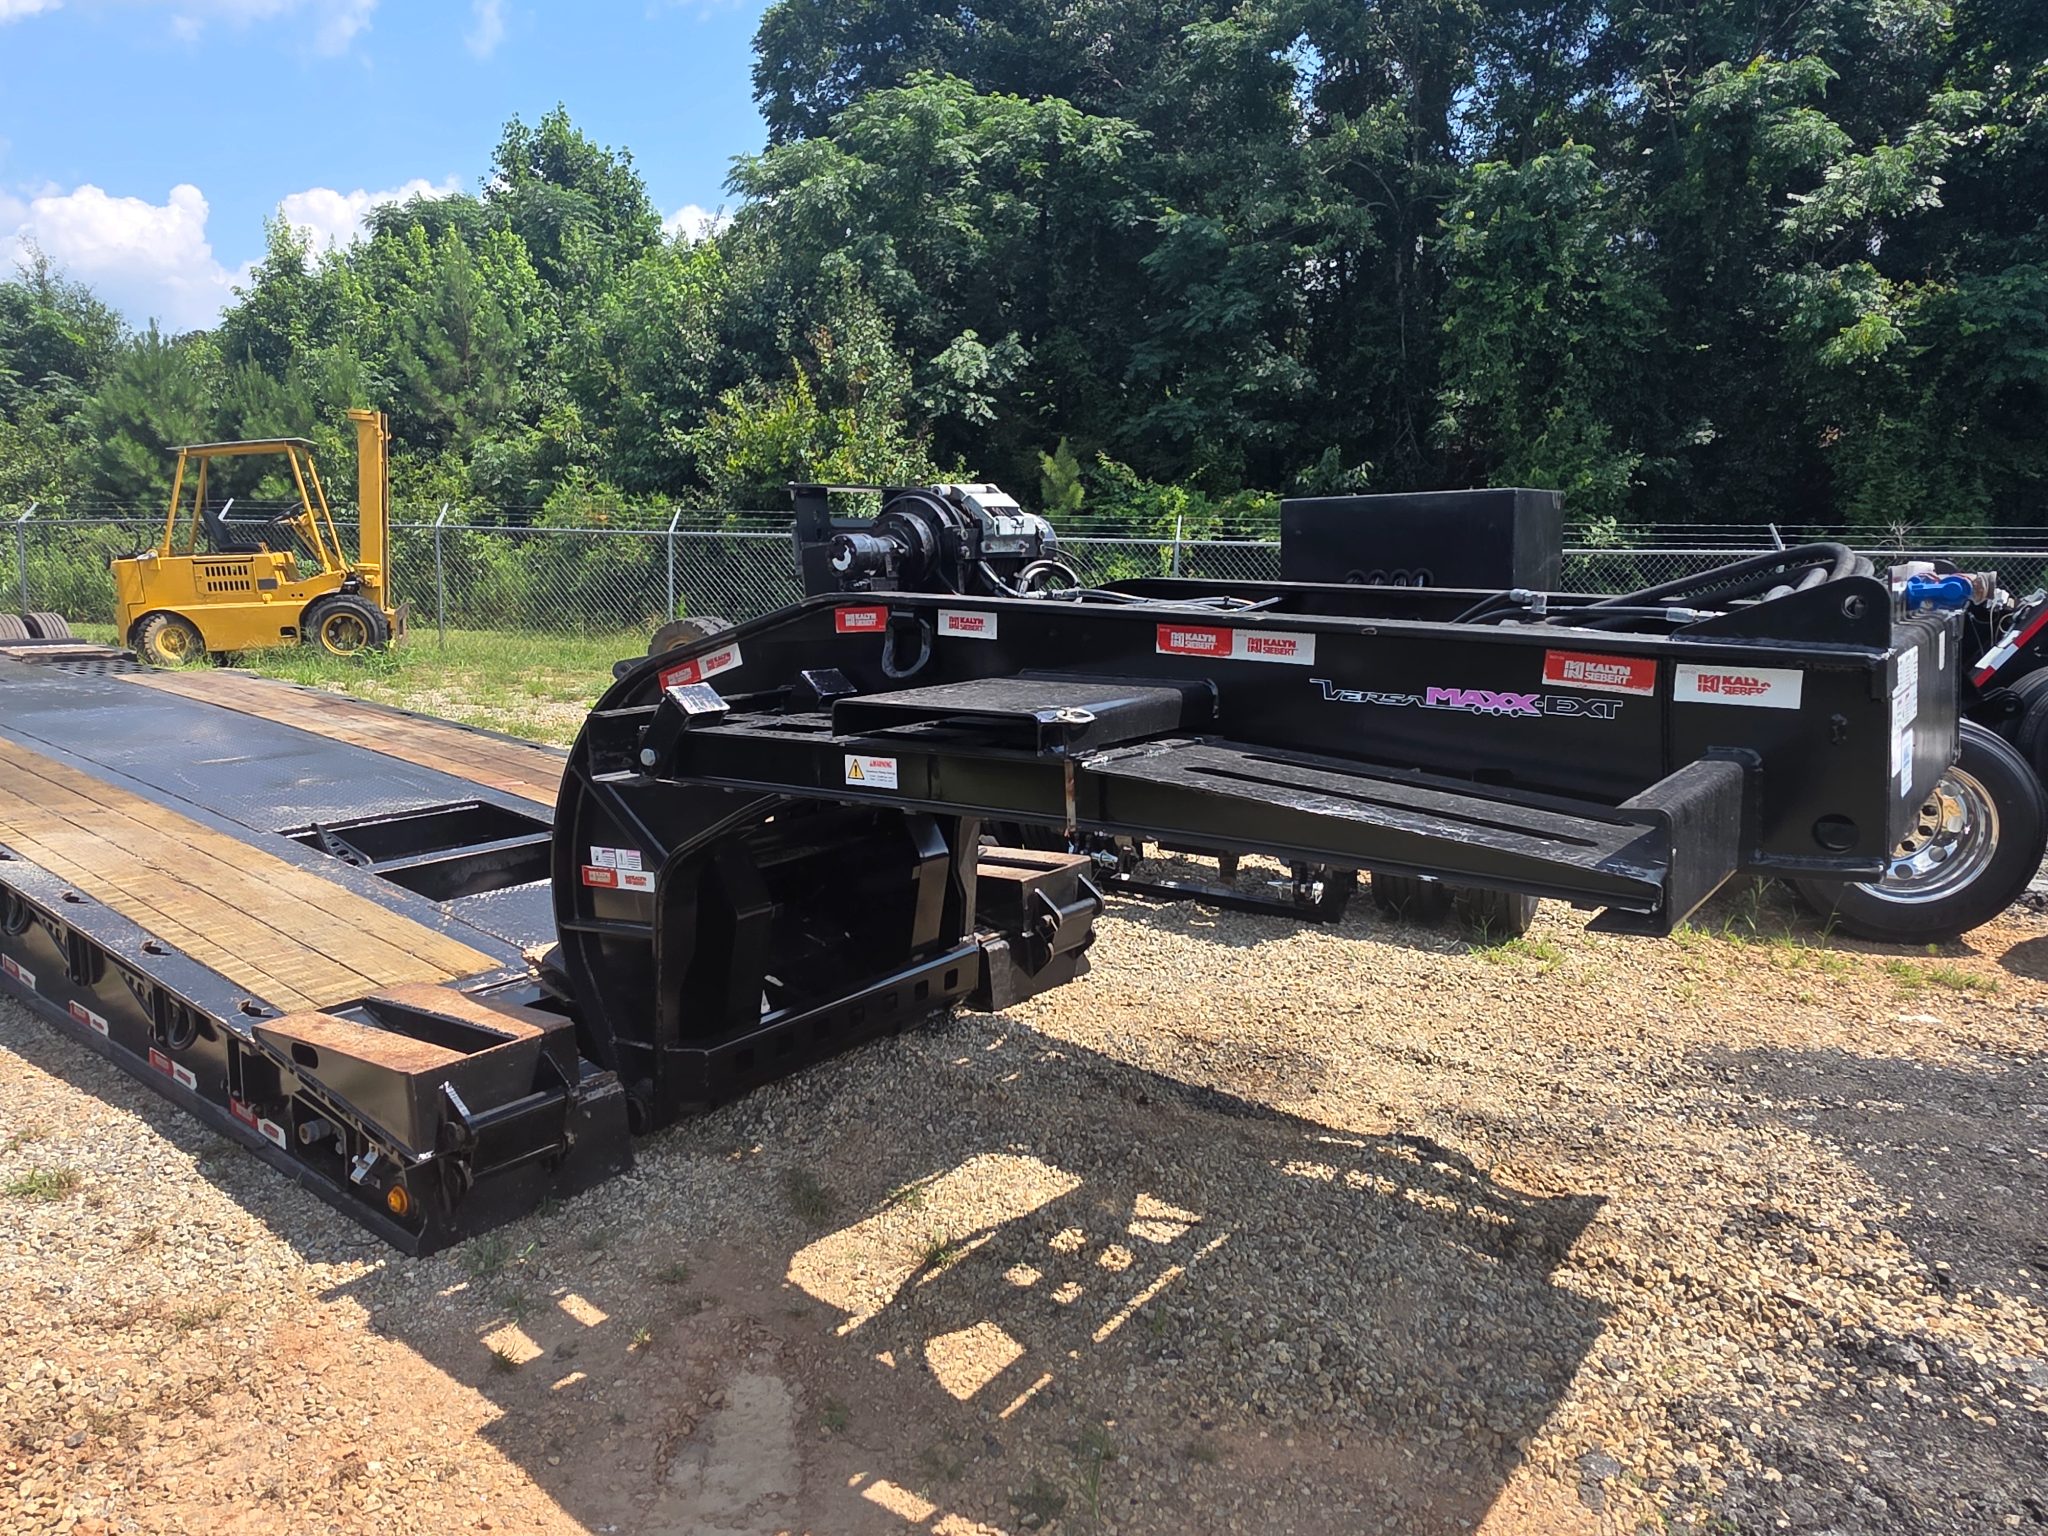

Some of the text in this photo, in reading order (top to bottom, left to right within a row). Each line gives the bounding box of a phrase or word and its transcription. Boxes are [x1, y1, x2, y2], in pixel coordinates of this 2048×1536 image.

[1184, 632, 1217, 643] KALYN
[1184, 640, 1216, 650] SIEBERT
[1263, 638, 1297, 648] KALYN
[1262, 646, 1297, 656] SIEBERT
[1585, 662, 1631, 676] KALYN
[1584, 671, 1630, 685] SIEBERT
